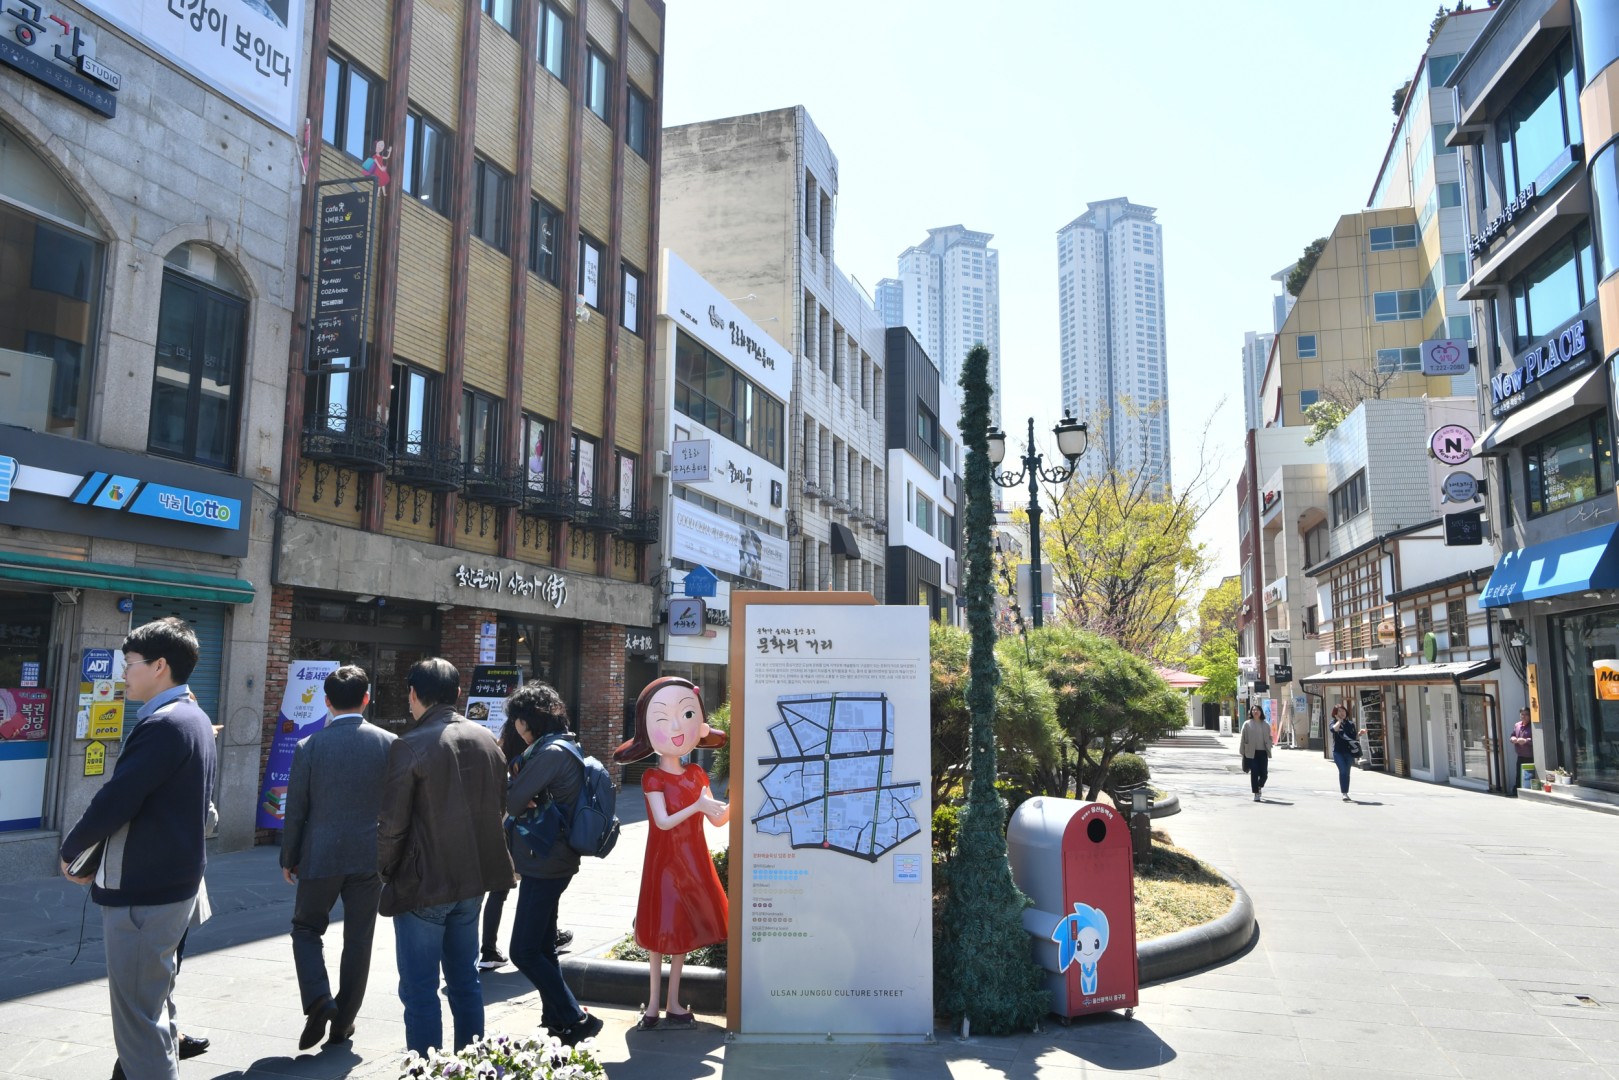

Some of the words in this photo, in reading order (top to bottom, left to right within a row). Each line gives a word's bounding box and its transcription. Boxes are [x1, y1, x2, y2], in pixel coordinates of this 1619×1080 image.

[233, 24, 291, 87] 보인다
[84, 60, 119, 85] STUDIO
[1525, 319, 1586, 384] PLACE
[1445, 438, 1461, 453] N
[159, 493, 181, 510] 나눔
[183, 495, 230, 521] Lotto
[757, 636, 798, 654] 문화의
[805, 639, 833, 655] 거리
[87, 660, 109, 672] ADT
[21, 704, 45, 716] 복권
[96, 727, 118, 735] proto
[770, 989, 797, 997] ULSAN
[799, 989, 832, 997] JUNGGU
[834, 989, 871, 997] CULTURE
[873, 989, 904, 997] STREET
